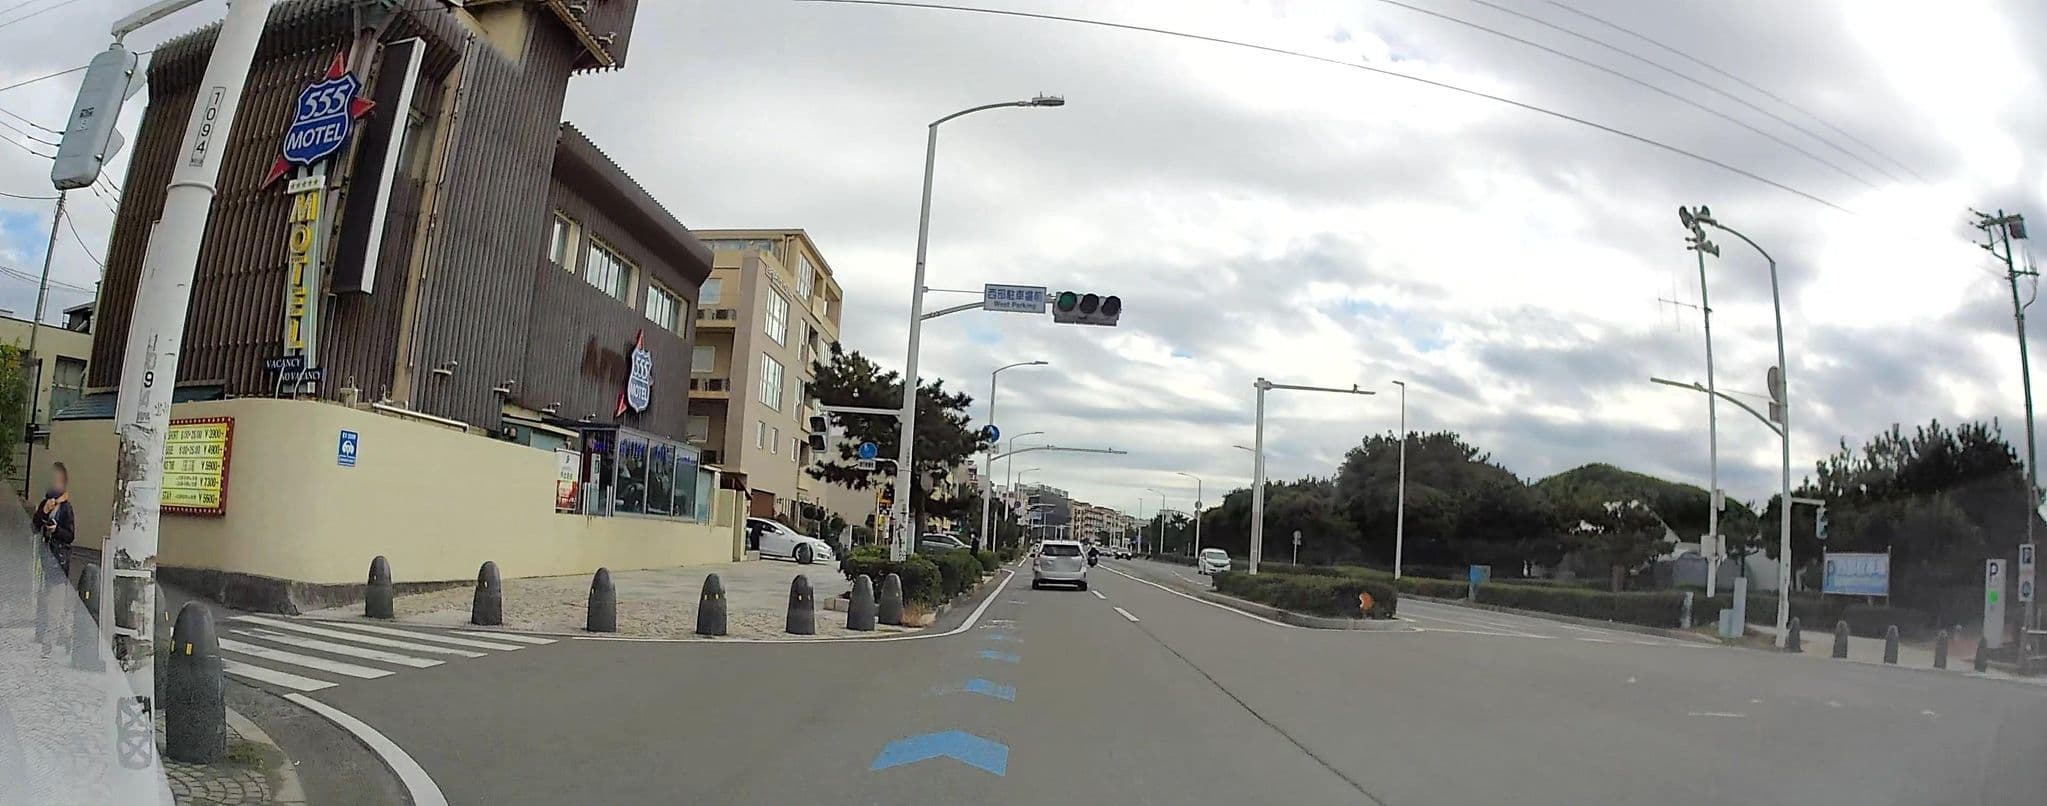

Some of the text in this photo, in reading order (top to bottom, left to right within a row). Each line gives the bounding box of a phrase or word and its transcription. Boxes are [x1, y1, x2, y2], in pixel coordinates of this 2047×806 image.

[302, 84, 350, 120] 555
[196, 91, 221, 154] 1094
[287, 123, 342, 151] MOTEL
[289, 192, 318, 349] MOTEL
[266, 358, 301, 369] VACANCY
